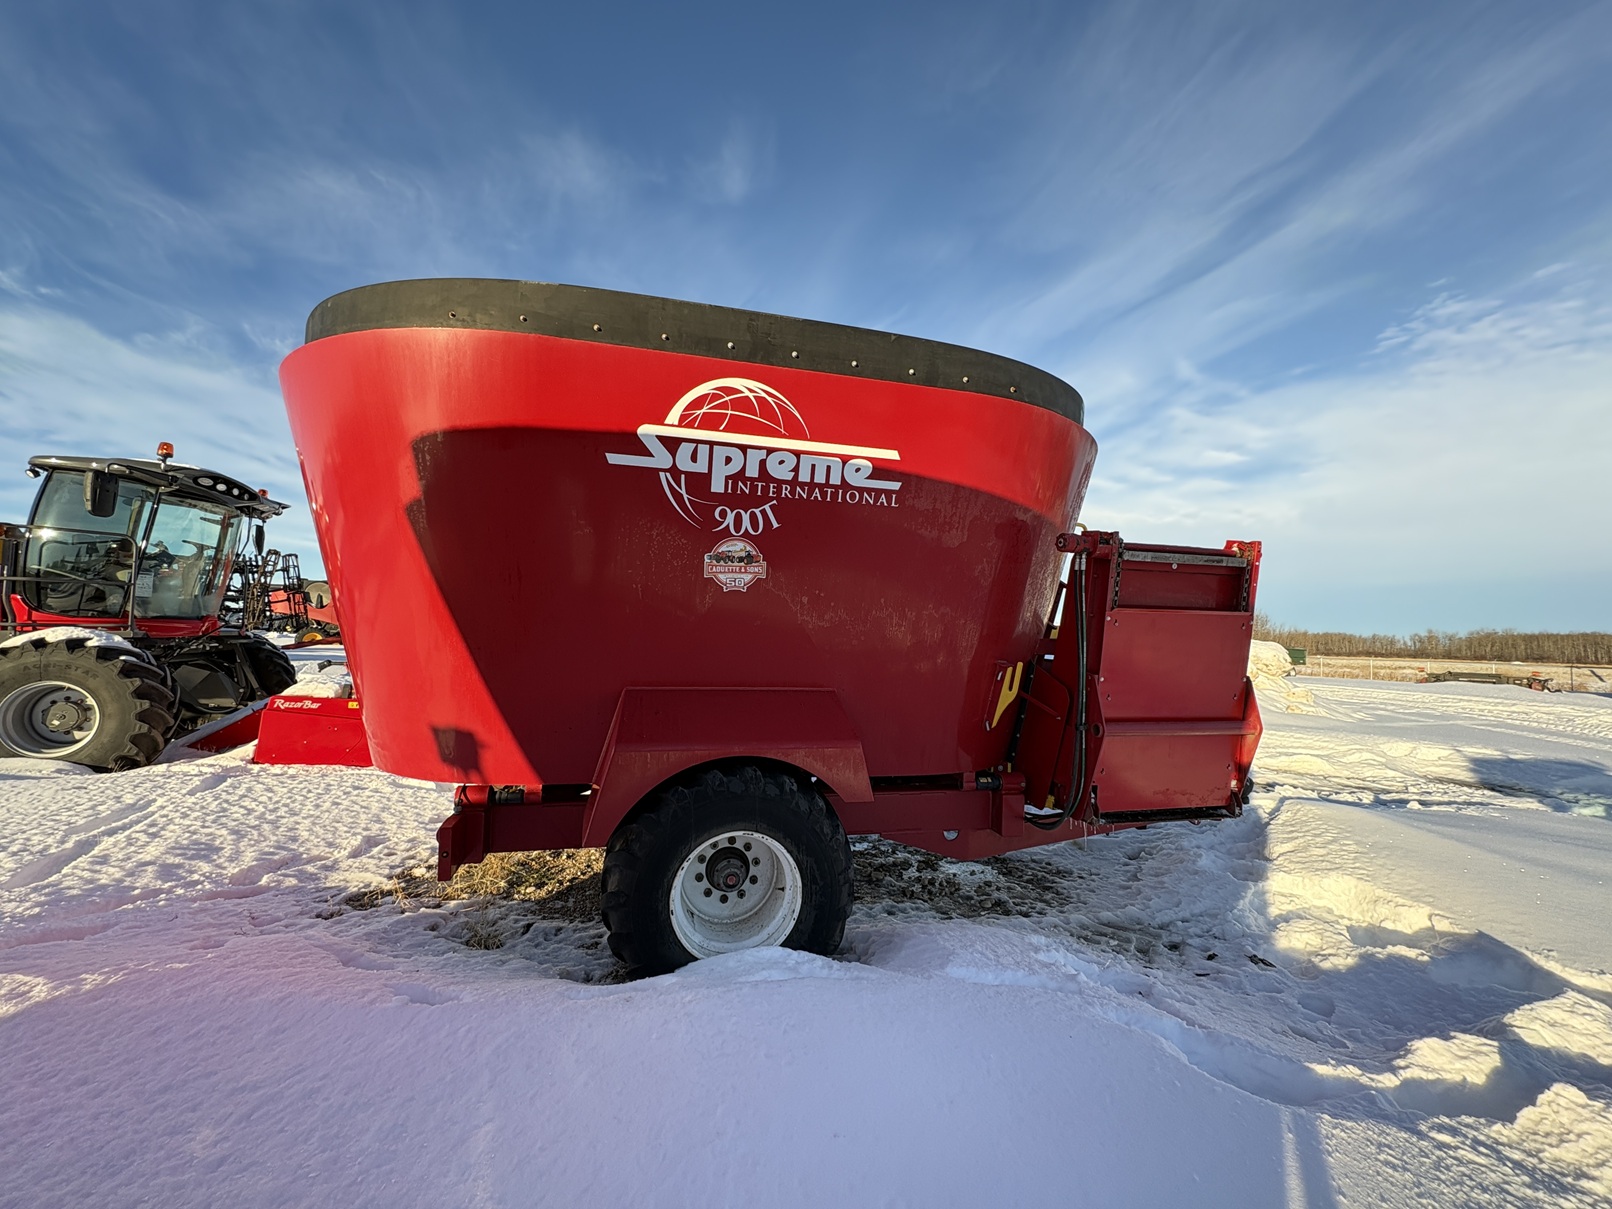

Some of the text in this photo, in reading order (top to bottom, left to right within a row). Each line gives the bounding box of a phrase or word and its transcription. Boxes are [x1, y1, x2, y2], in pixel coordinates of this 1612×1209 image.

[605, 424, 902, 493] Supreme
[727, 479, 900, 507] INTERNATIONAL
[712, 501, 781, 536] 900T
[726, 578, 745, 587] 50
[273, 699, 322, 709] RazorBar
